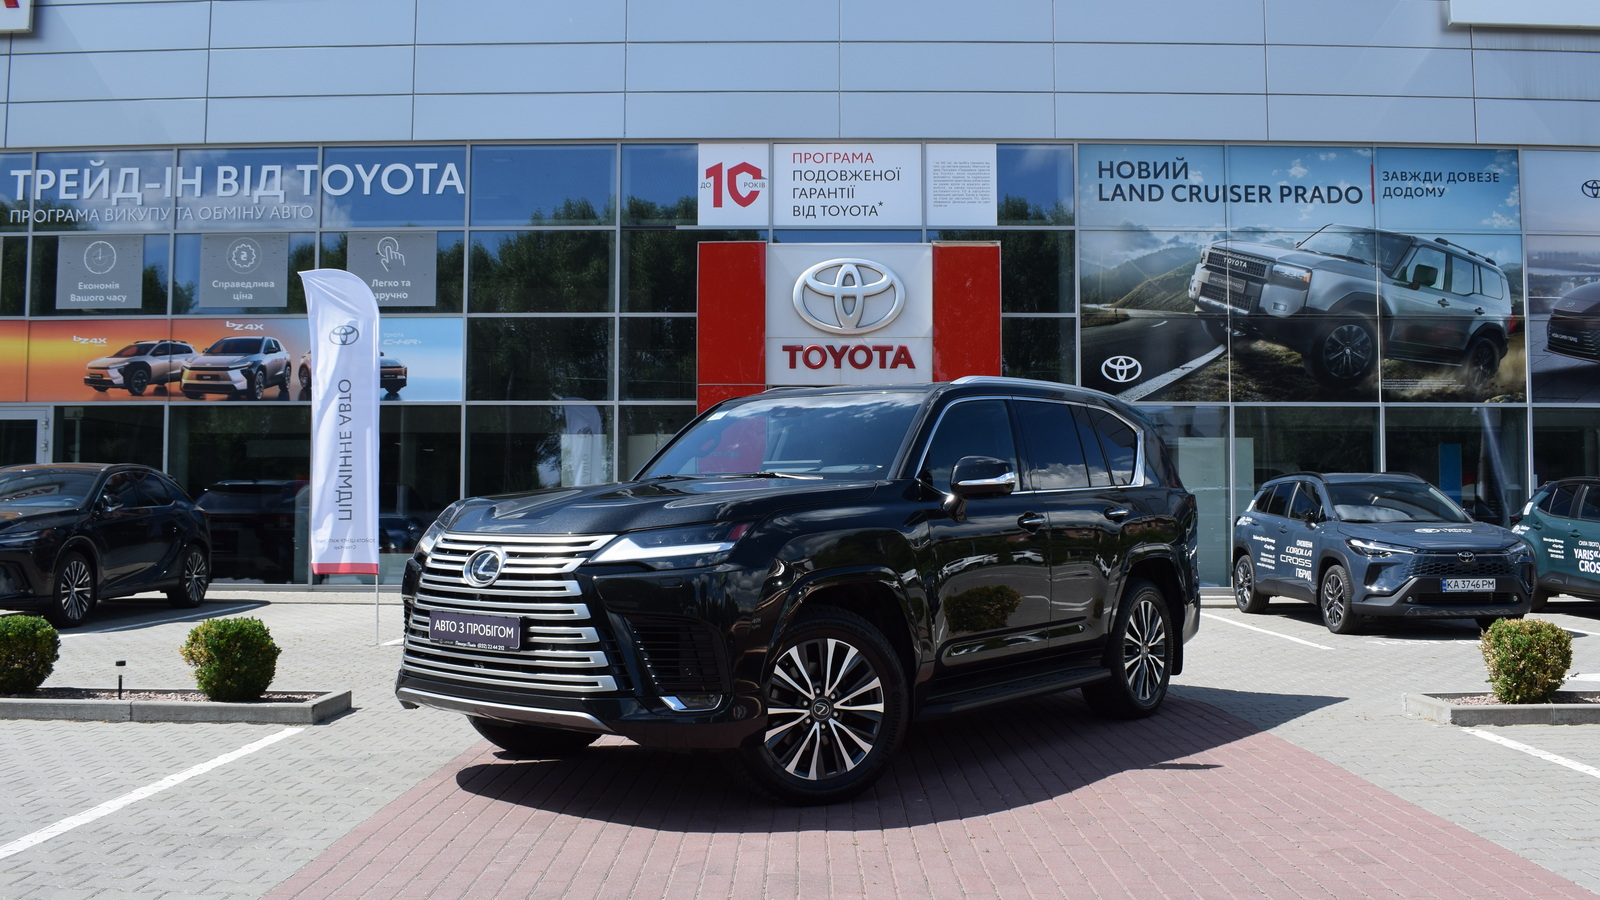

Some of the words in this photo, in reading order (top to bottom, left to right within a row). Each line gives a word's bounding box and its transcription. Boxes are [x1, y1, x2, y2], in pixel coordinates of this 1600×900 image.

[792, 152, 875, 164] ПРОГРАМА
[792, 166, 902, 183] ПОДОВЖЕНОЇ
[1098, 157, 1190, 181] НОВИЙ
[10, 160, 203, 206] ТРЕЙД-ІН
[216, 165, 285, 204] ВІД
[296, 163, 465, 196] TOYOTA
[1382, 170, 1443, 185] ЗАВЖДИ
[1446, 170, 1500, 185] ДОВЕЗЕ
[700, 181, 712, 190] ДО
[743, 181, 766, 189] РОКІВ
[792, 184, 856, 199] ГАРАНТІЇ
[1098, 184, 1165, 203] LAND
[1170, 184, 1272, 204] CRUISER
[1279, 184, 1364, 205] PRADO
[1382, 185, 1446, 201] ДОДОМУ
[9, 208, 100, 223] ПРОГРАМА
[105, 207, 171, 221] ВИКУПУ
[175, 206, 193, 220] ТА
[198, 206, 266, 220] ОБМІНУ
[269, 205, 314, 219] АВТО
[792, 204, 817, 219] ВІД
[1223, 257, 1247, 268] TOYOTA
[78, 281, 120, 290] Економія
[212, 280, 275, 290] Справедлива
[371, 279, 399, 287] Легко
[70, 293, 105, 302] Вашого
[106, 294, 127, 303] часу
[233, 291, 253, 301] ціна
[374, 292, 408, 301] зручно
[782, 344, 916, 370] TOYOTA
[1285, 546, 1313, 557] COROLLA
[1280, 554, 1312, 568] CROSS
[1447, 580, 1460, 589] KA
[1461, 580, 1481, 589] 3746
[1481, 580, 1495, 589] PM
[434, 619, 457, 633] АВТО
[466, 622, 515, 639] ПРОБІГОМ
